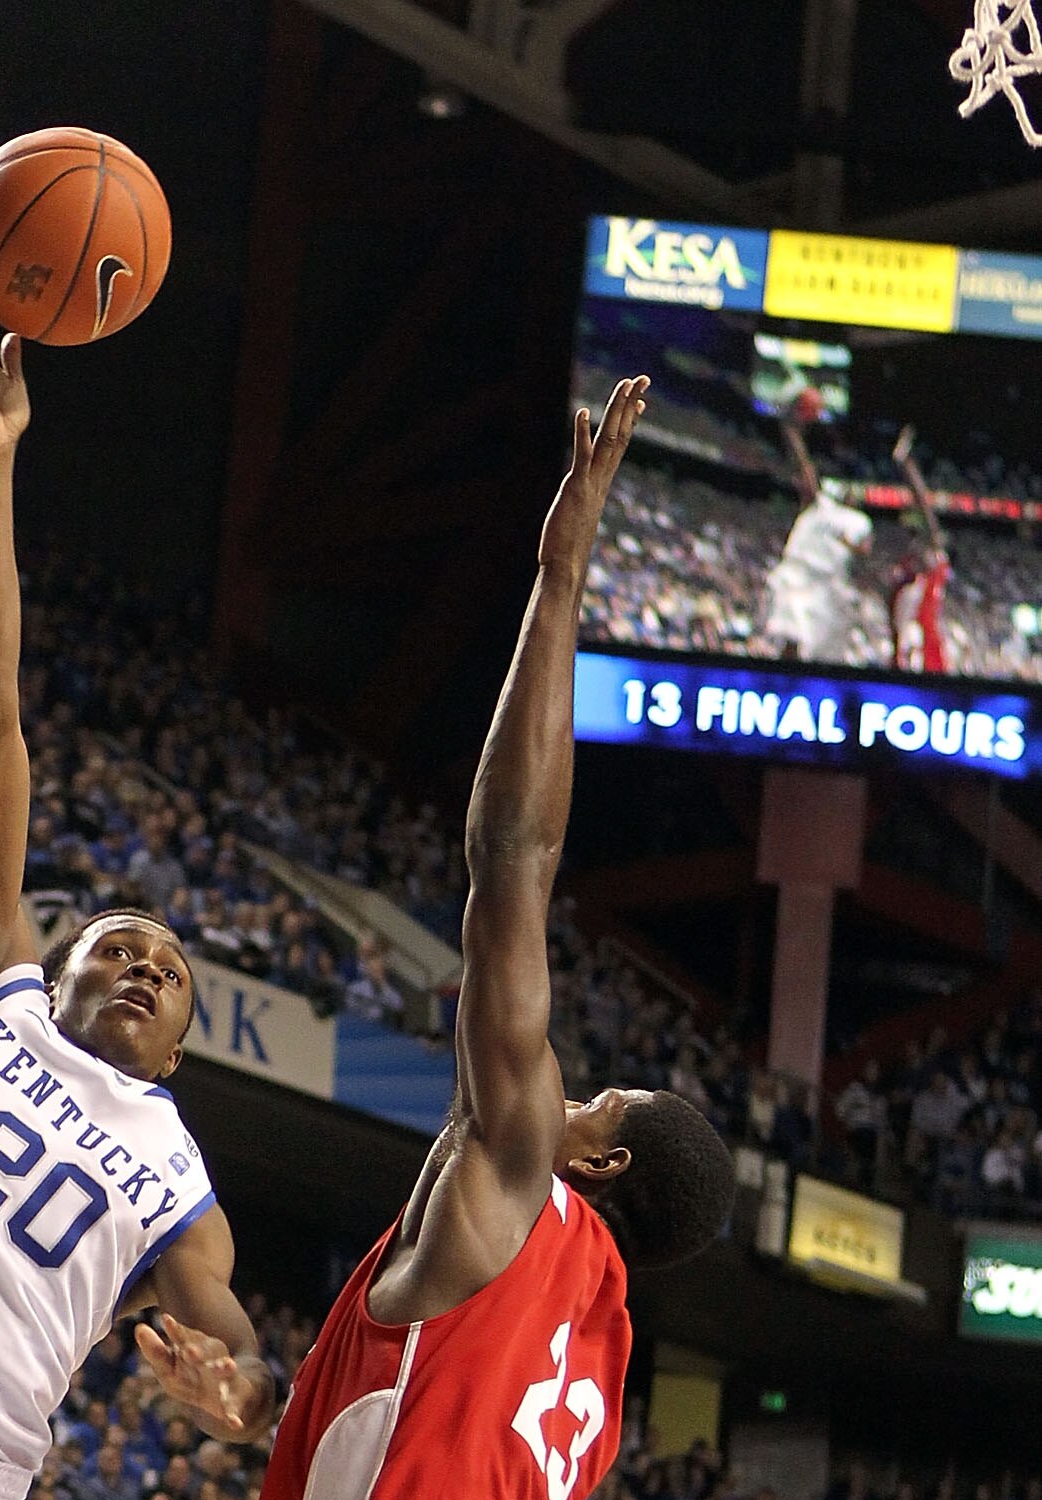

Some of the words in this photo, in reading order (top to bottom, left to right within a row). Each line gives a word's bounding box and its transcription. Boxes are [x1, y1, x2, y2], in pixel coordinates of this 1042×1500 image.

[605, 215, 747, 290] KESA
[623, 679, 682, 728] 13
[696, 685, 846, 744] FINAL
[859, 702, 1025, 762] FOURS
[192, 976, 271, 1064] NK
